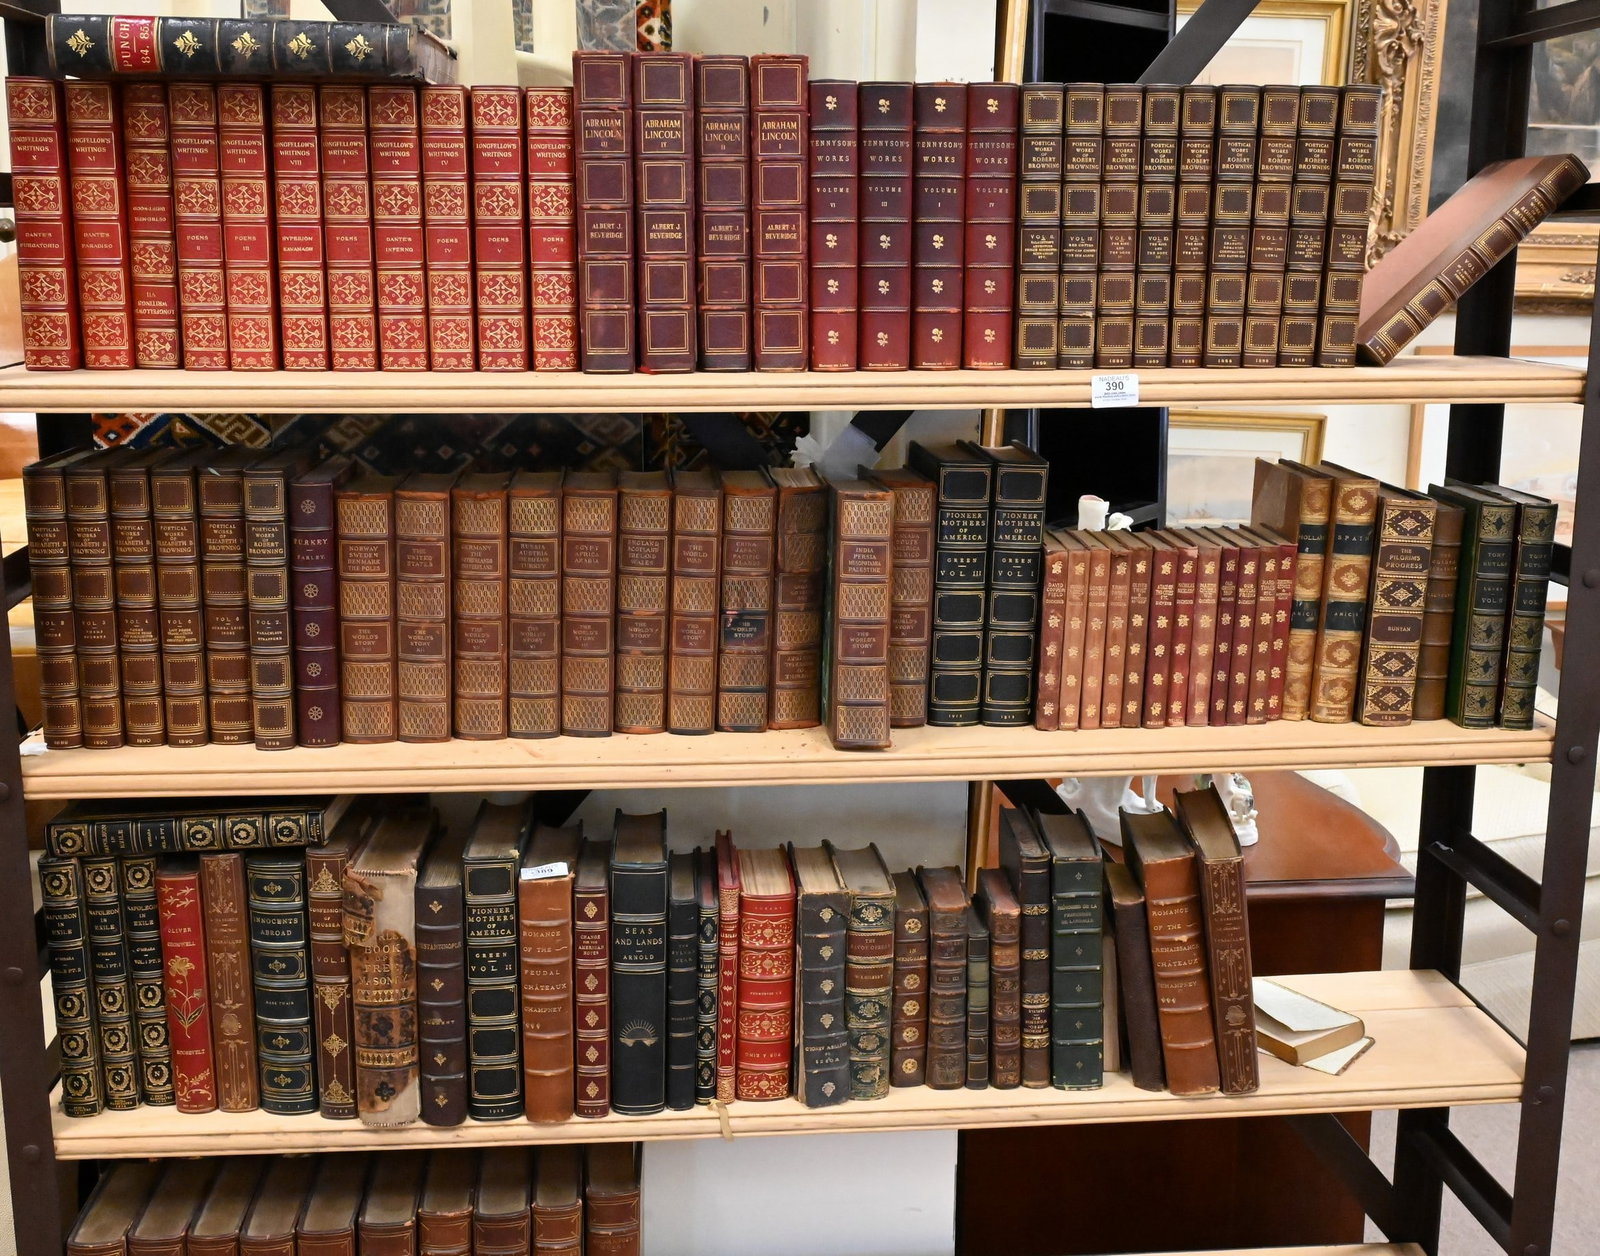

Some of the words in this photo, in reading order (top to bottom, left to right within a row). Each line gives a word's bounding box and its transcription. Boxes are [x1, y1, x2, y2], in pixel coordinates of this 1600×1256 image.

[120, 23, 133, 68] PUNCH
[584, 118, 622, 128] ABRAHAM
[644, 119, 681, 129] ABRAHAM
[705, 121, 742, 131] ABRAHAM
[761, 120, 799, 131] ABRAHAM
[584, 129, 622, 139] LINCOLN
[644, 130, 681, 140] LINCOLN
[704, 132, 742, 143] LINCOLN
[761, 131, 799, 142] LINCOLN
[475, 142, 518, 150] LONGFELLOW'S
[529, 142, 572, 151] LONGFELLOW'S
[810, 139, 857, 148] TENNYSON'S
[862, 139, 911, 149] TENNYSON'S
[916, 140, 964, 149] TENNYSON'S
[968, 142, 1016, 150] TENNYSON'S
[16, 145, 50, 153] WRITINGS
[74, 146, 107, 154] WRITINGS
[176, 147, 209, 155] WRITINGS
[225, 148, 258, 156] WRITINGS
[279, 149, 311, 157] WRITINGS
[327, 149, 359, 157] WRITINGS
[379, 150, 411, 158] WRITINGS
[427, 150, 460, 158] WRITINGS
[481, 150, 513, 158] WRITINGS
[535, 151, 567, 159] WRITINGS
[869, 155, 904, 163] WORKS
[922, 156, 956, 164] WORKS
[975, 157, 1009, 165] WORKS
[1027, 162, 1060, 170] BROWNING
[1341, 163, 1373, 171] BROWNING
[591, 223, 616, 231] ALBERT
[651, 223, 675, 231] ALBERT
[766, 223, 791, 231] ALBERT
[590, 231, 624, 240] BEVERIDGE
[649, 232, 683, 240] BEVERIDGE
[707, 233, 742, 241] BEVERIDGE
[764, 232, 798, 241] BEVERIDGE
[137, 300, 168, 308] WRITINGS
[1105, 381, 1125, 392] 390
[945, 511, 983, 519] PIONEER
[1001, 511, 1039, 520] PIONEER
[940, 519, 987, 527] MOTHERS
[996, 519, 1042, 527] MOTHERS
[293, 538, 329, 546] TURKEY
[997, 534, 1037, 542] AMERICA
[1337, 534, 1370, 542] SPAIN
[1389, 554, 1421, 562] PILGRIM'S
[1385, 561, 1423, 569] PROGRESS
[847, 566, 882, 574] PALESTINE
[88, 908, 120, 916] NAPOLEON
[471, 907, 510, 915] PIONEER
[1151, 908, 1189, 916] ROMANCE
[253, 916, 299, 925] INNOCENTS
[467, 914, 514, 923] MOTHERS
[260, 929, 292, 937] ABROAD
[469, 929, 512, 937] AMERICA
[625, 927, 653, 935] SEAS
[614, 938, 633, 946] AND
[636, 937, 664, 946] LANDS
[363, 945, 401, 954] BOOK
[523, 983, 567, 991] CHÂTEAUX
